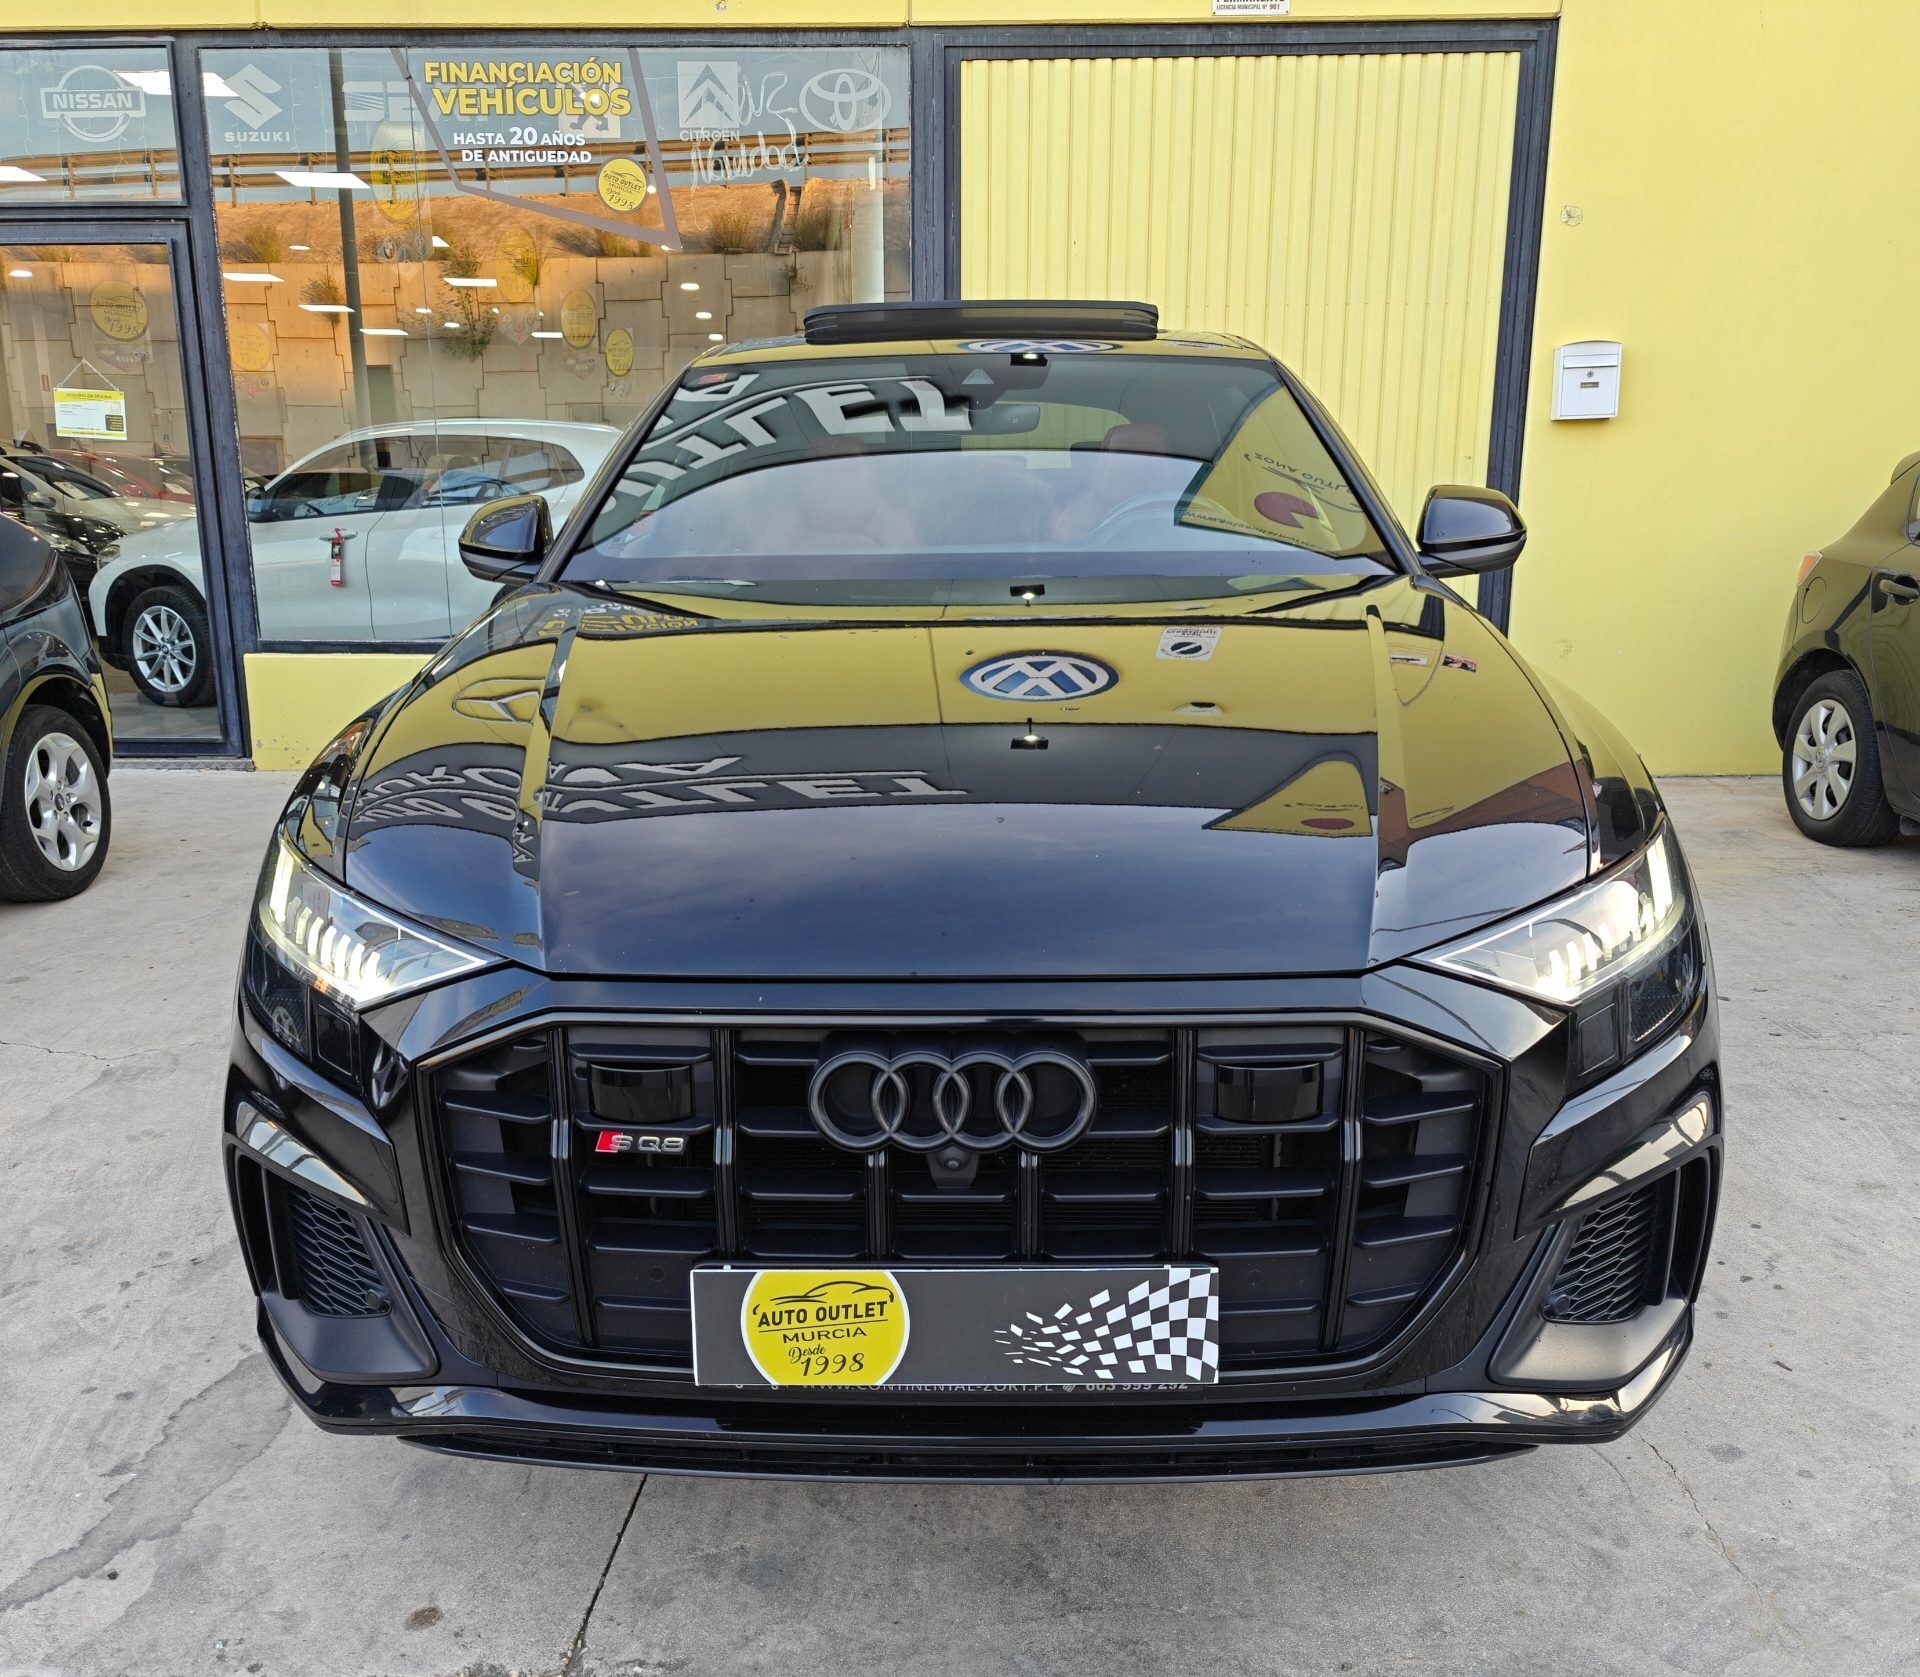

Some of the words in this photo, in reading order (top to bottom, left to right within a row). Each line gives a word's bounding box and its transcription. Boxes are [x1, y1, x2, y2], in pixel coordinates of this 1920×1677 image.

[424, 57, 622, 83] FINANCIACIÓN
[52, 92, 133, 110] NISSAN
[432, 81, 631, 116] VEHÍCULOS
[224, 131, 290, 142] SUZUKI
[453, 132, 505, 145] HASTA
[508, 126, 538, 145] 20
[540, 130, 586, 146] AÑOS
[461, 150, 483, 162] DE
[487, 150, 592, 163] ANTIGUEDAD
[603, 173, 620, 182] AUTO
[620, 179, 642, 191] OUTLET
[608, 194, 635, 209] 1998
[757, 1309, 808, 1328] AUTO
[815, 1301, 888, 1322] OUTLET
[783, 1327, 867, 1344] MURCIA
[788, 1344, 826, 1364] Desde
[800, 1352, 865, 1376] 1998
